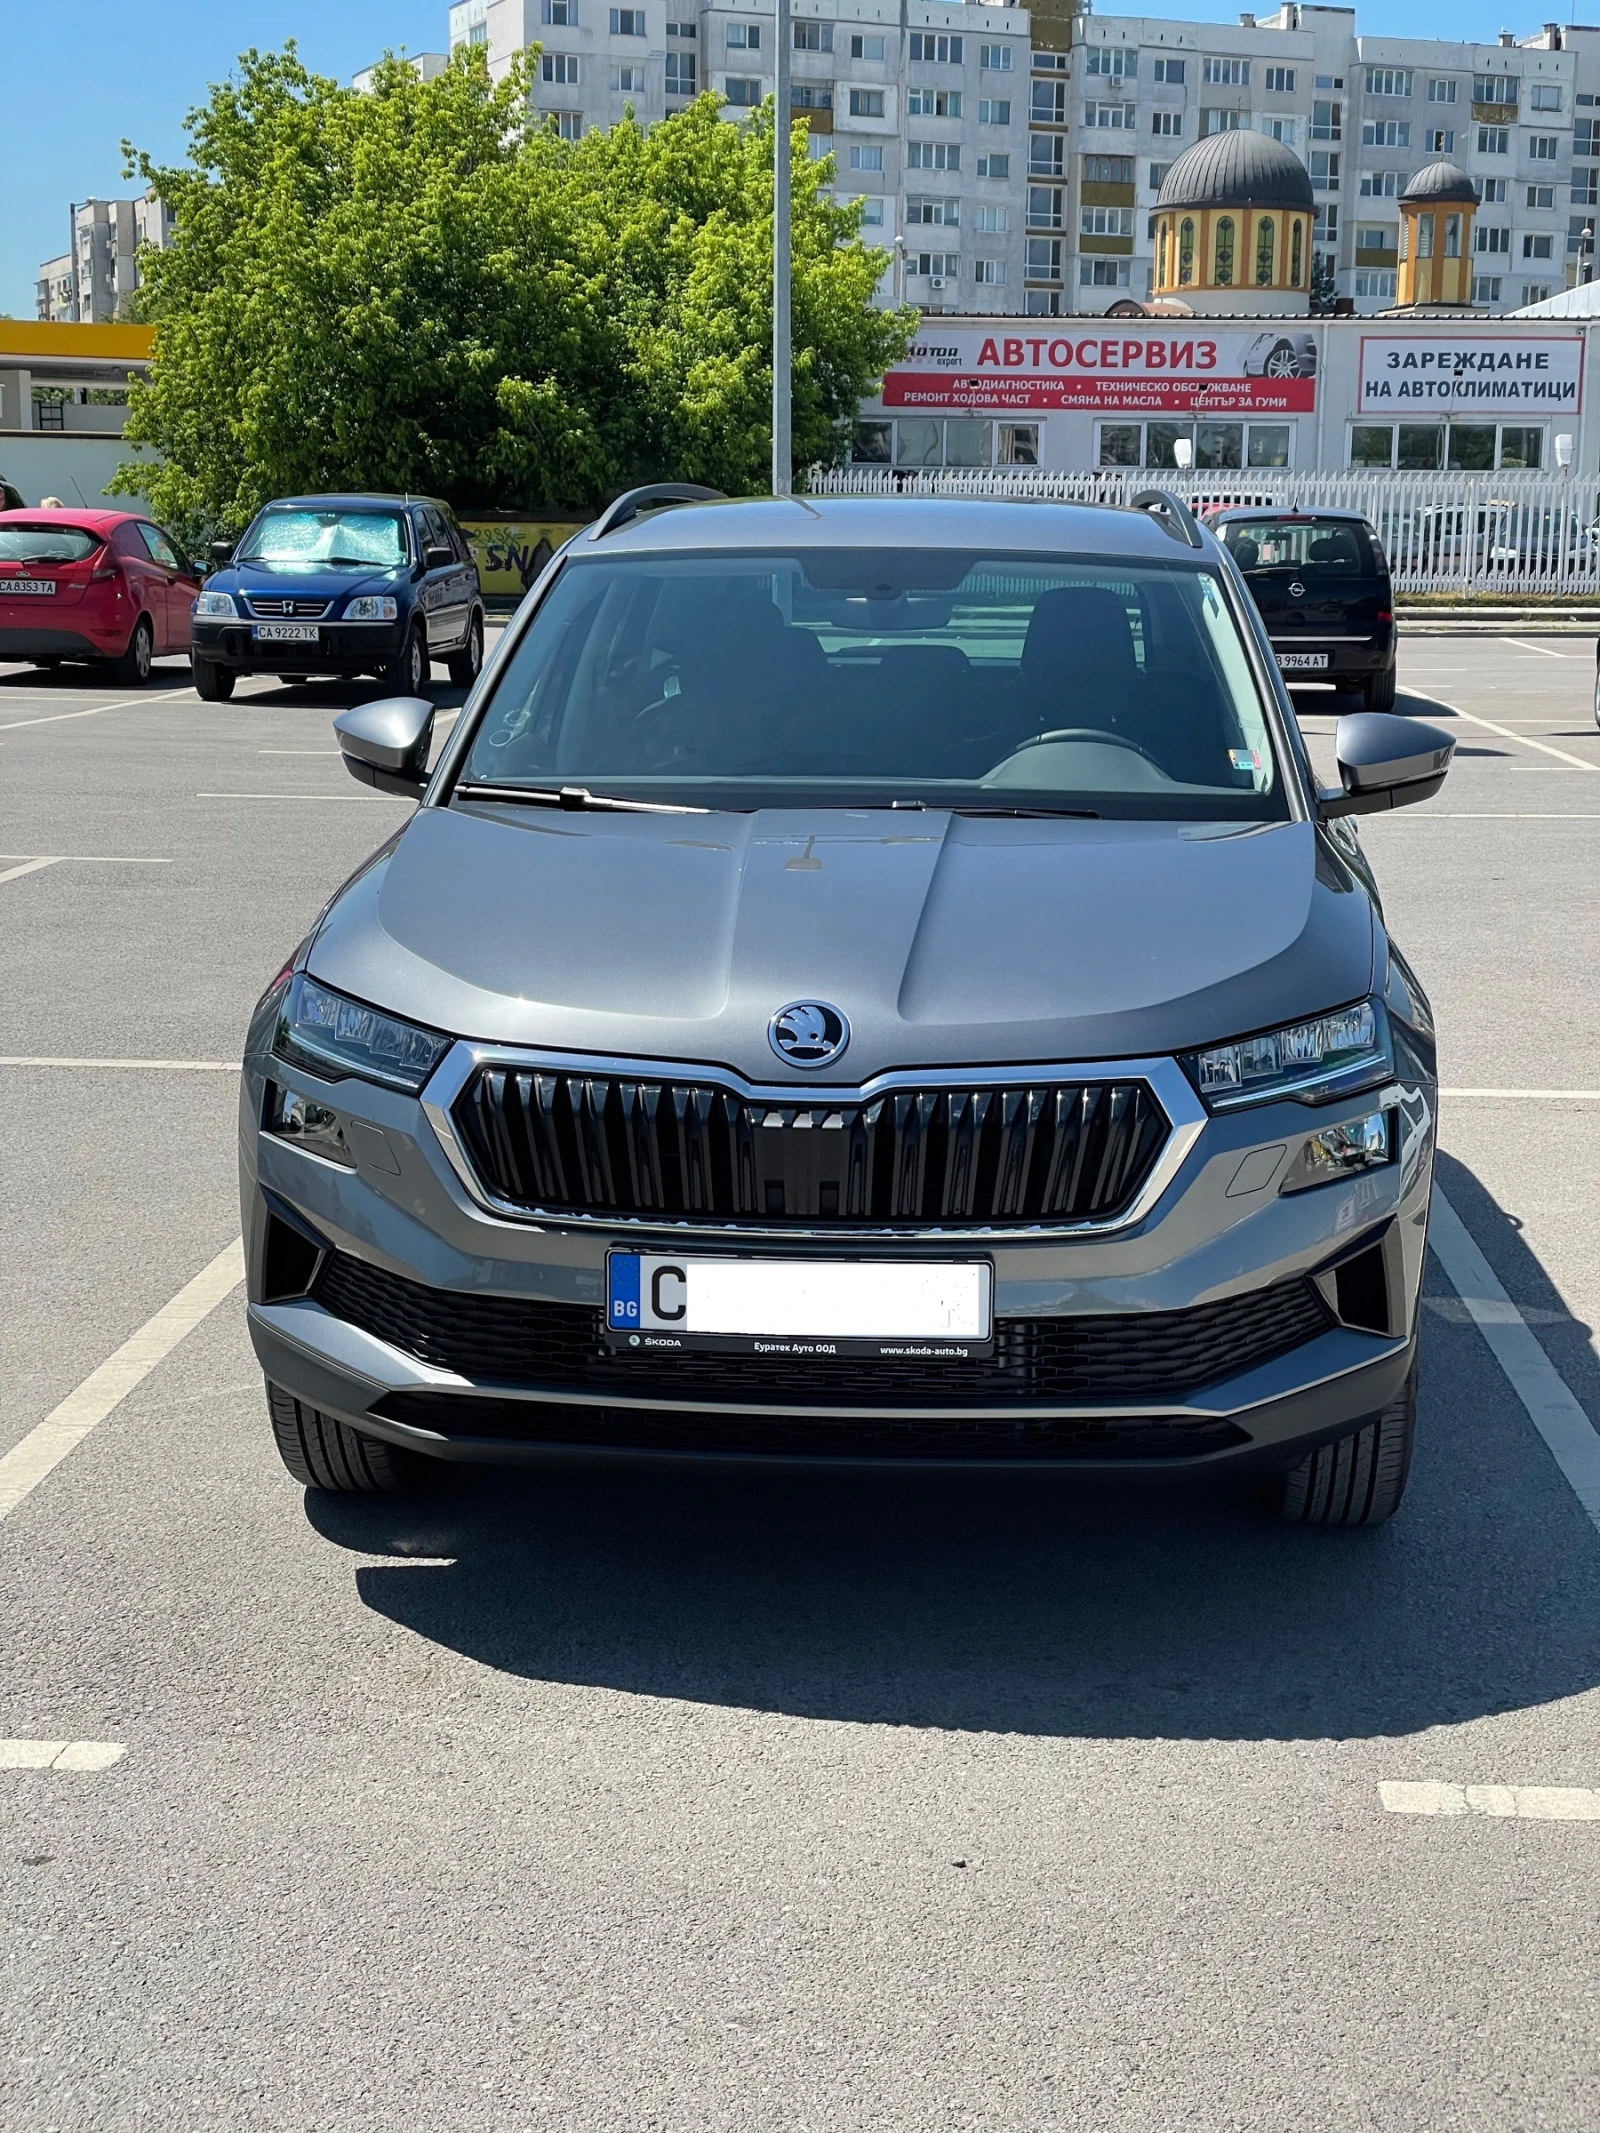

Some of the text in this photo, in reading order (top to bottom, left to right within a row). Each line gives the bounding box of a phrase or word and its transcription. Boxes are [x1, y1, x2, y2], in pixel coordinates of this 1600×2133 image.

[977, 338, 1217, 369] АВТОСЕРВИЗ
[937, 358, 962, 367] expert
[1387, 352, 1549, 372] ЗАРЕЖДАНЕ
[953, 379, 1065, 391] АВДИАГНОСТИКА
[1096, 381, 1170, 392] ТЕХНИЧЕСКО
[1365, 381, 1576, 401] НА АВТОКЛИМАТИЦИ
[904, 392, 1031, 404] РЕМОНТ ХОДОВА ЧАСТ
[1061, 395, 1162, 406] СМЯНА НА МАСЛА
[1190, 397, 1287, 407] ЦЕНТЪР ЗА ГУМИ
[0, 581, 53, 592] CA 8353 TA
[259, 627, 316, 638] CA 9222 TK
[1284, 656, 1310, 666] 9964
[1313, 656, 1327, 666] AT
[651, 1265, 686, 1321] C
[614, 1300, 638, 1317] BG
[644, 1337, 682, 1347] ŠKODA
[754, 1342, 837, 1354] Еуратек Ауто ООД
[880, 1346, 968, 1357] www.skoda-auto.bg
